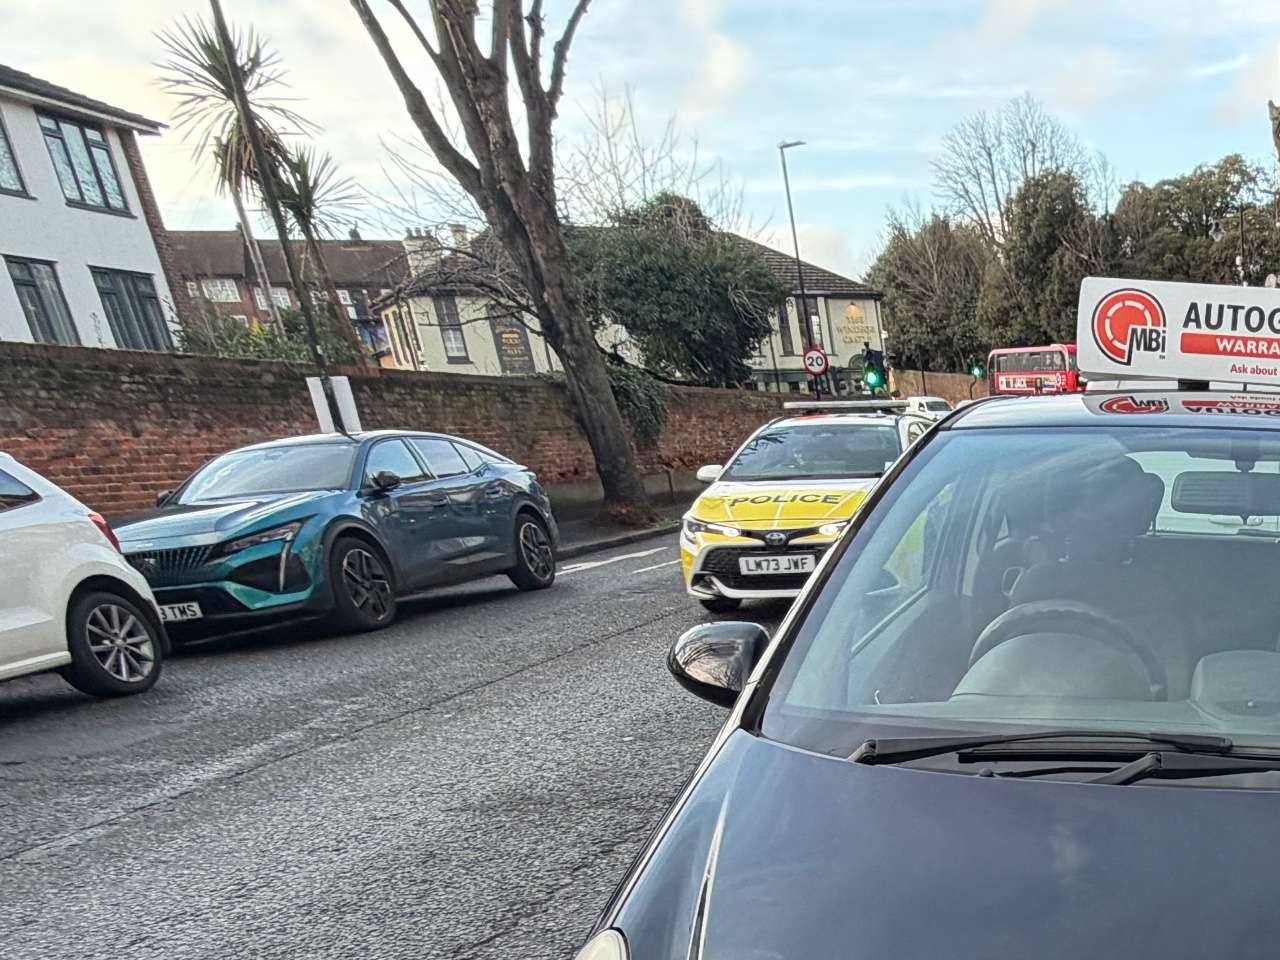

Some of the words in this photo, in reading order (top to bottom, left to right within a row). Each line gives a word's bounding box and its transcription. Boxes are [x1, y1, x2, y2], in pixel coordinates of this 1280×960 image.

[807, 356, 823, 367] 20
[1230, 364, 1248, 375] Ask
[1250, 364, 1278, 377] about
[729, 494, 842, 507] POLICE
[745, 558, 780, 572] LM73
[784, 557, 809, 570] JWF
[168, 604, 198, 619] TMS
